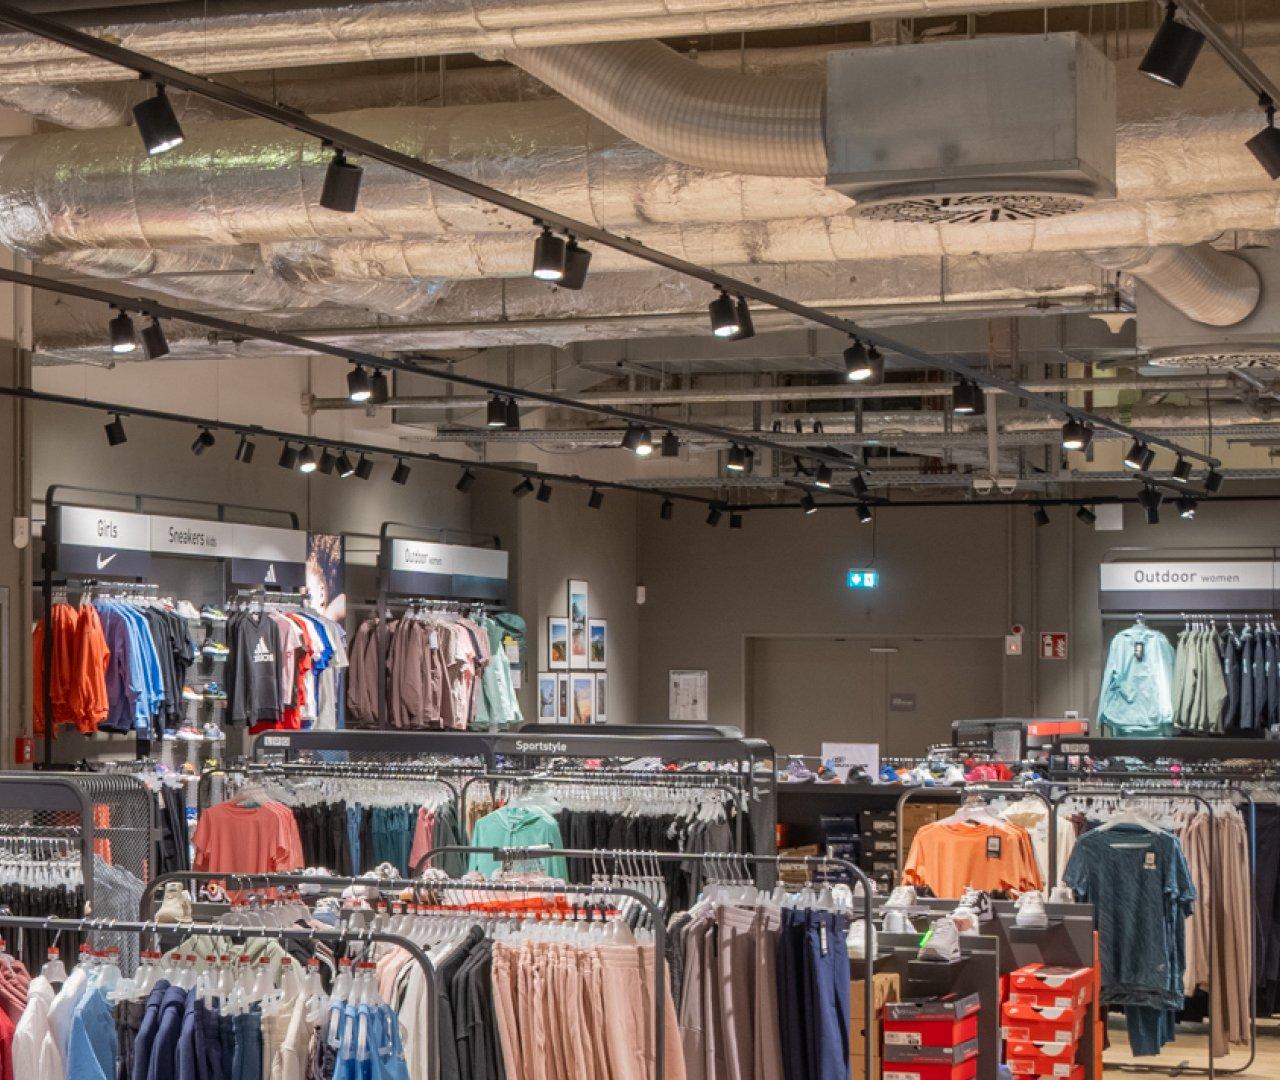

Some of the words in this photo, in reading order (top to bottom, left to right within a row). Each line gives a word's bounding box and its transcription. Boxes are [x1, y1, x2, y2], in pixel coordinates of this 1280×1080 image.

[97, 519, 118, 538] Girls
[169, 526, 205, 546] Sneakers
[1133, 570, 1197, 583] Outdoor
[1200, 574, 1240, 583] women
[515, 740, 567, 753] Sportstyle
